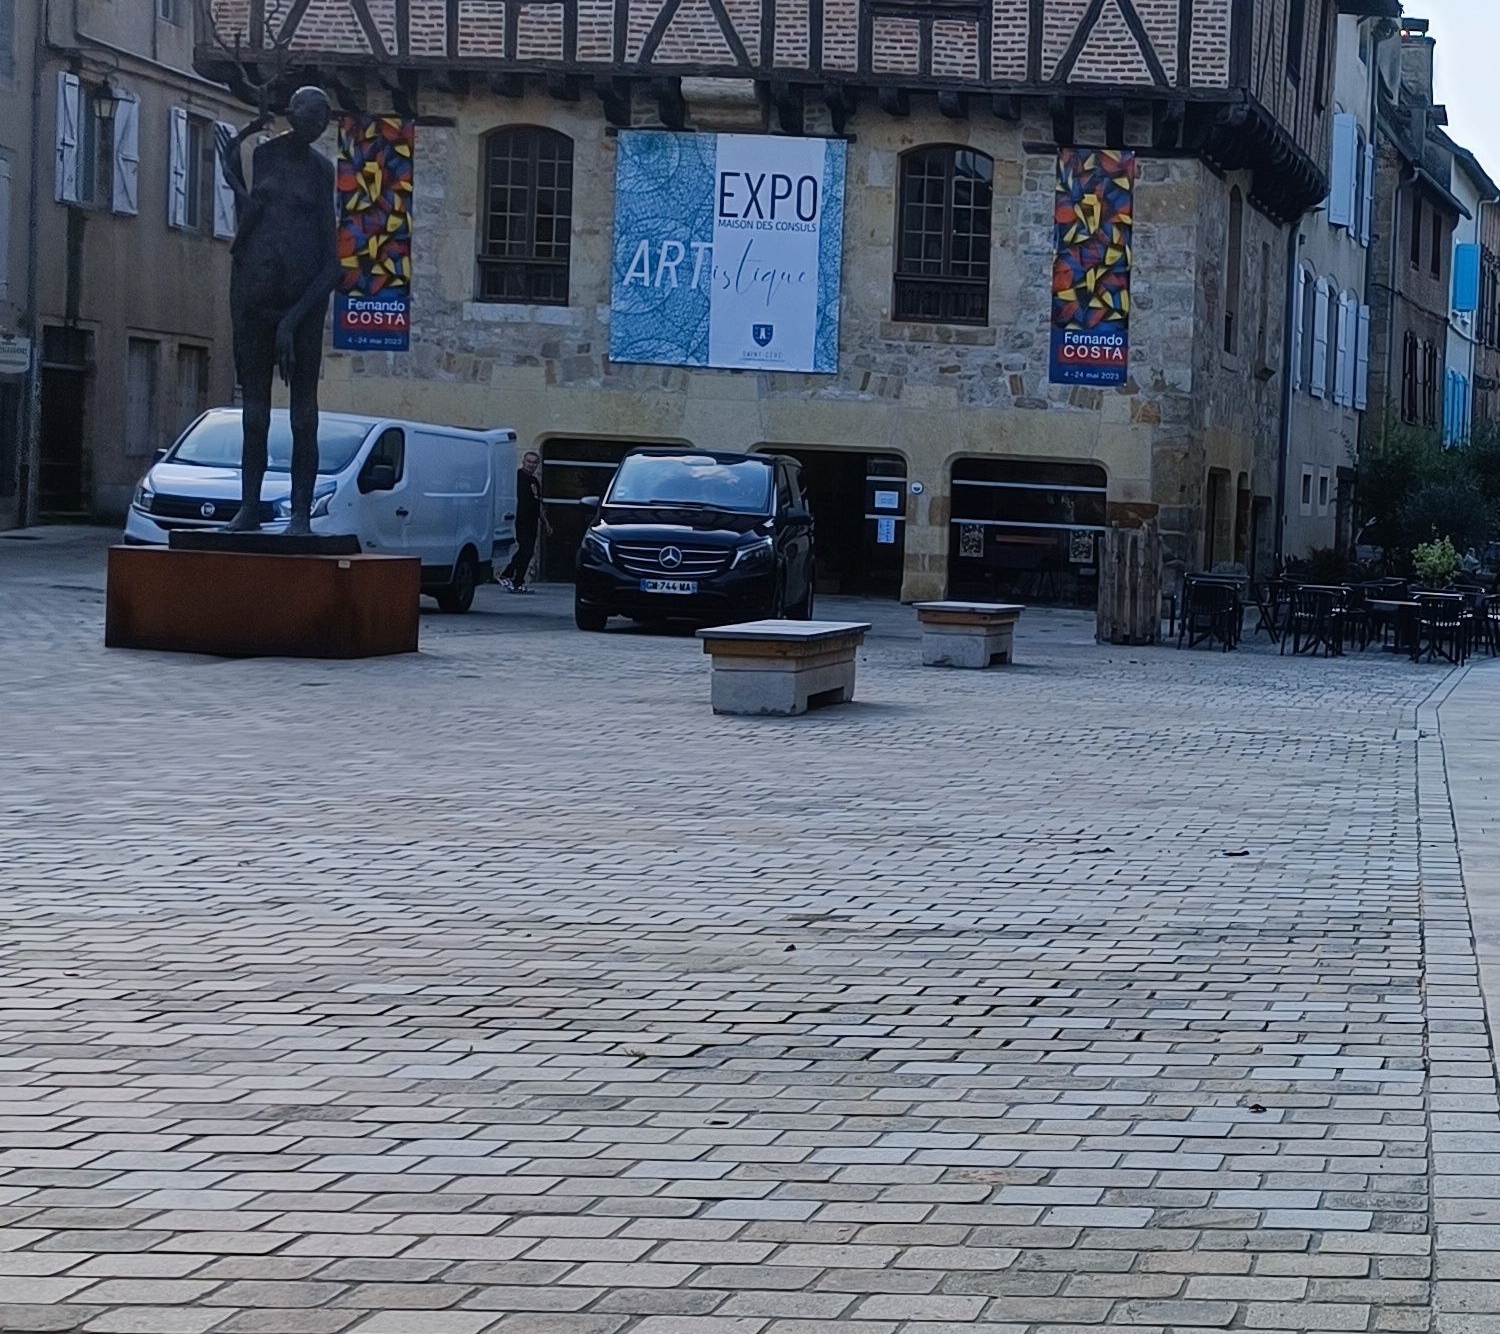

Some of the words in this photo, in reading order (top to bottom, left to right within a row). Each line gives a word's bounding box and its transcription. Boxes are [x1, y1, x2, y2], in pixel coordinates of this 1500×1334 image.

[718, 171, 818, 222] EXPO
[717, 218, 754, 230] MAISON
[756, 220, 773, 231] DES
[775, 222, 817, 233] CONSULS
[348, 298, 406, 312] Fernando
[347, 311, 406, 326] COSTA
[1064, 331, 1123, 346] Fernando
[1063, 345, 1123, 360] COSTA
[1101, 372, 1119, 380] 2023
